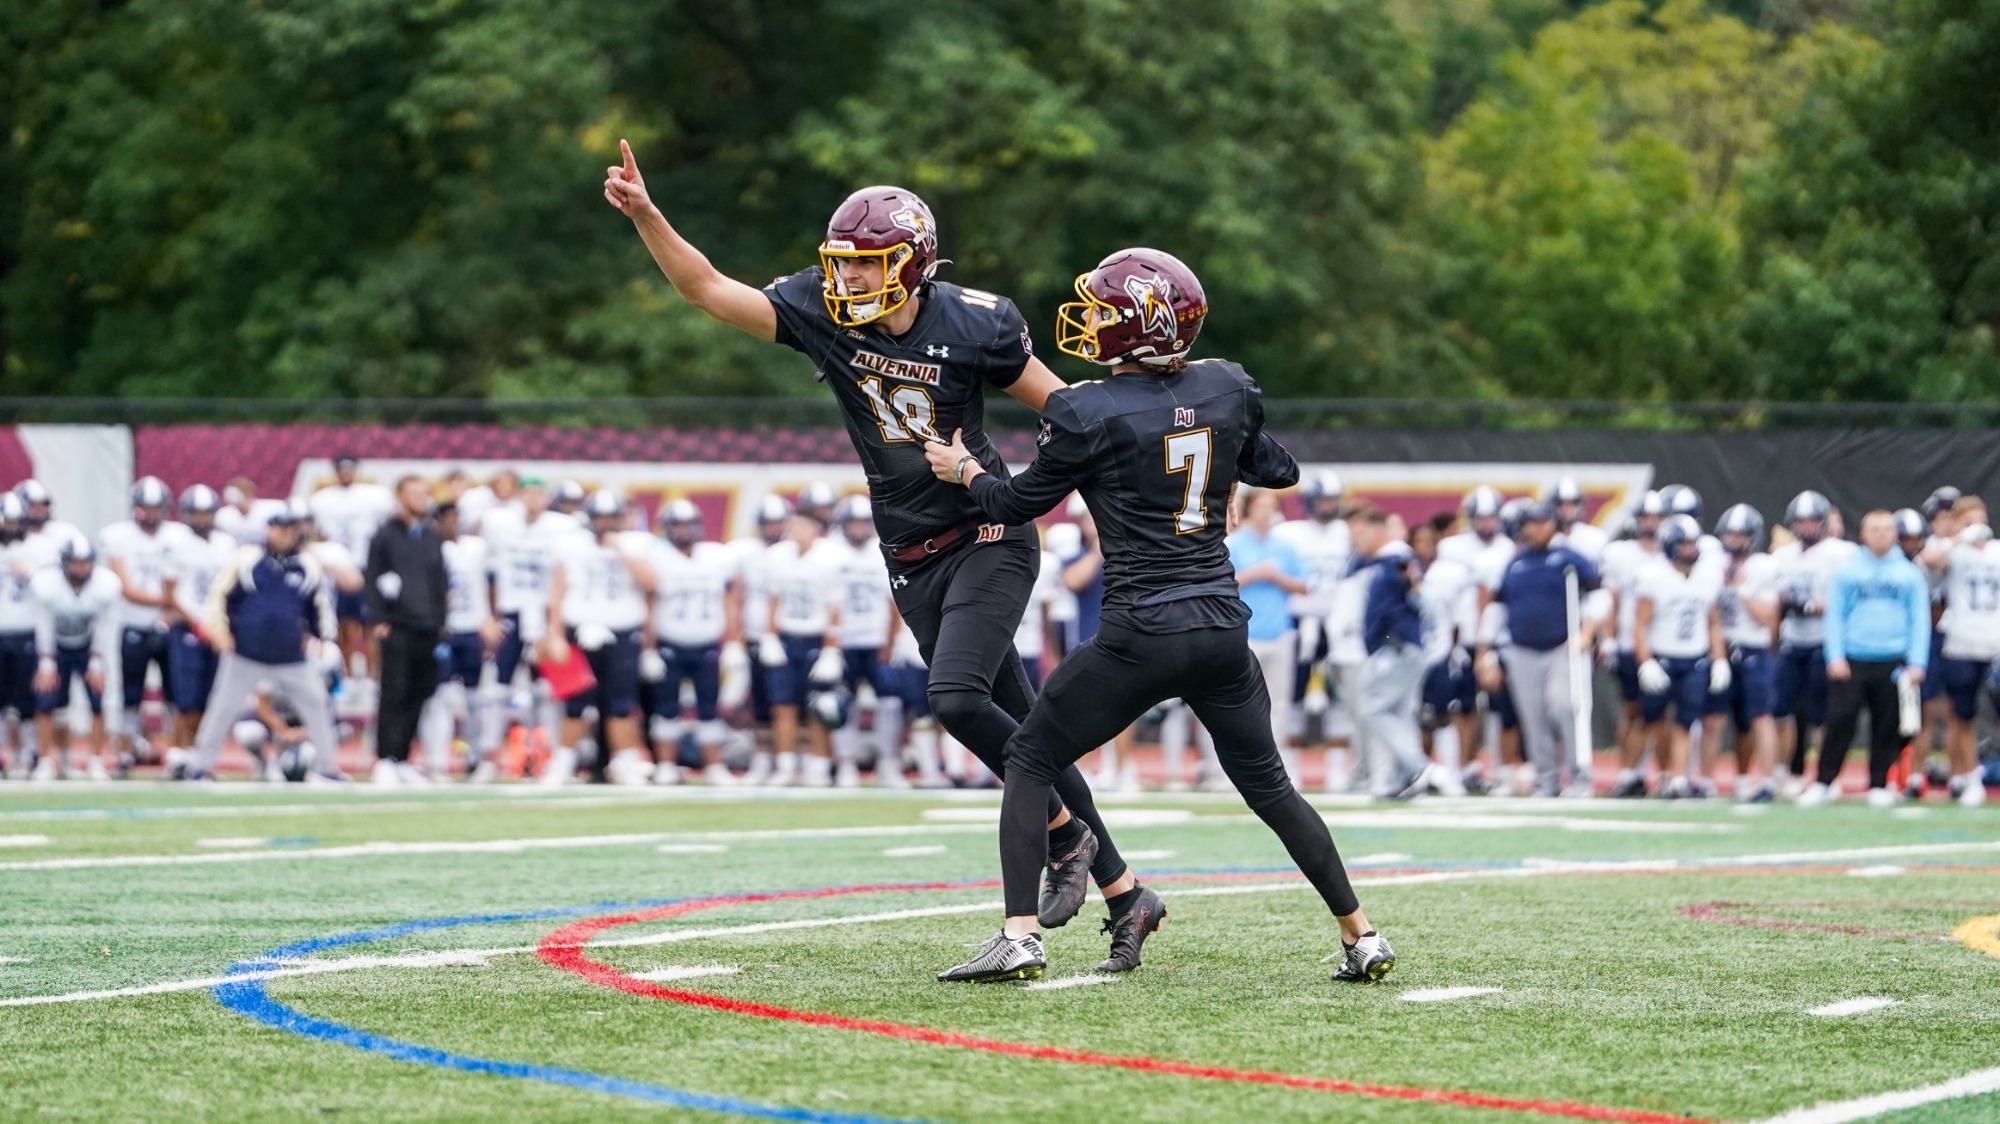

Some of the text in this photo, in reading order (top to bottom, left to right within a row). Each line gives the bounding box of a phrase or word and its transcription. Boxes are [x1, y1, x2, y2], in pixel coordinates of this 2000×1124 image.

[829, 242, 850, 250] Riddell
[852, 350, 940, 384] ALVERNIA
[857, 375, 946, 443] 18
[1174, 407, 1195, 428] AU
[1164, 427, 1212, 535] 7
[975, 523, 1005, 544] AU
[1018, 936, 1044, 959] NIKE
